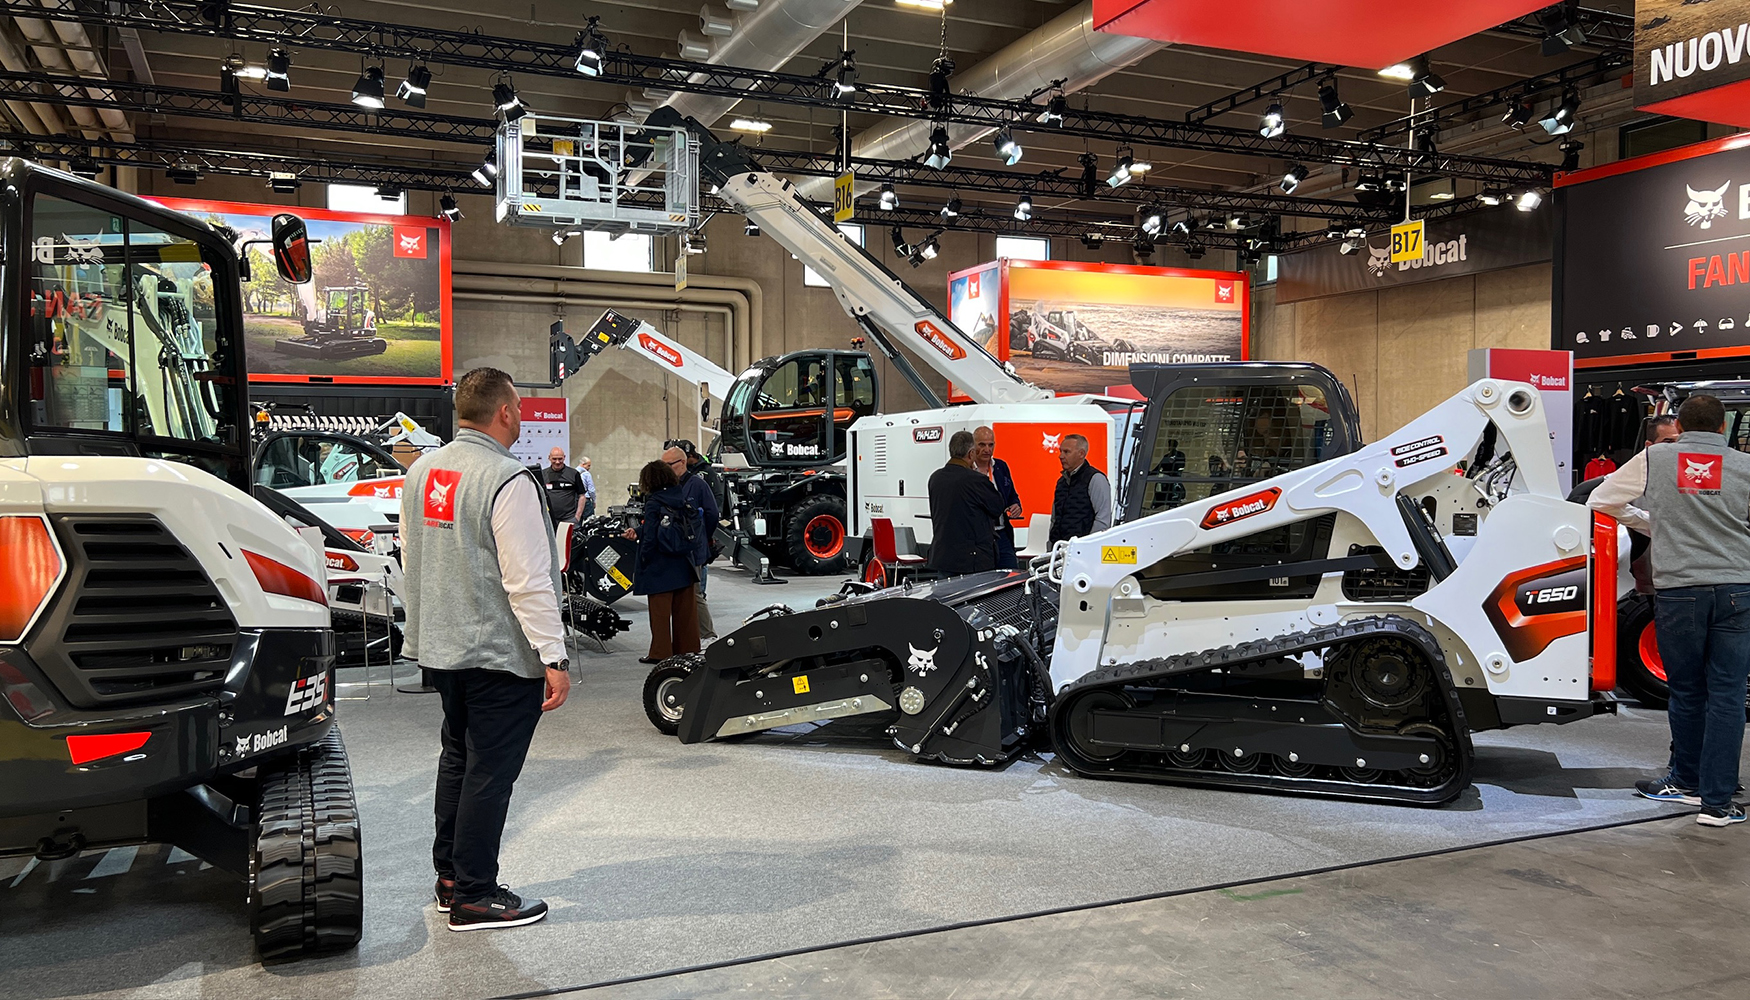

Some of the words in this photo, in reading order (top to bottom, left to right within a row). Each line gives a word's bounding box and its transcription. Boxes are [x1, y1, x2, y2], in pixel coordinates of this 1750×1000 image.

[1650, 23, 1750, 86] NUOV
[835, 182, 852, 213] B16
[1392, 229, 1421, 254] B17
[1687, 250, 1750, 290] FAN
[931, 333, 955, 356] Bobcat
[656, 346, 677, 363] Bobcat
[1103, 351, 1170, 366] DIMENSIONI
[1541, 376, 1566, 386] Bobcat
[787, 444, 819, 456] Bobcat
[1410, 437, 1441, 450] CONTROL
[1402, 449, 1441, 464] TWO-SPEED
[1231, 499, 1265, 518] Bobcat
[1525, 586, 1578, 604] T650
[253, 725, 288, 752] Bobcat
